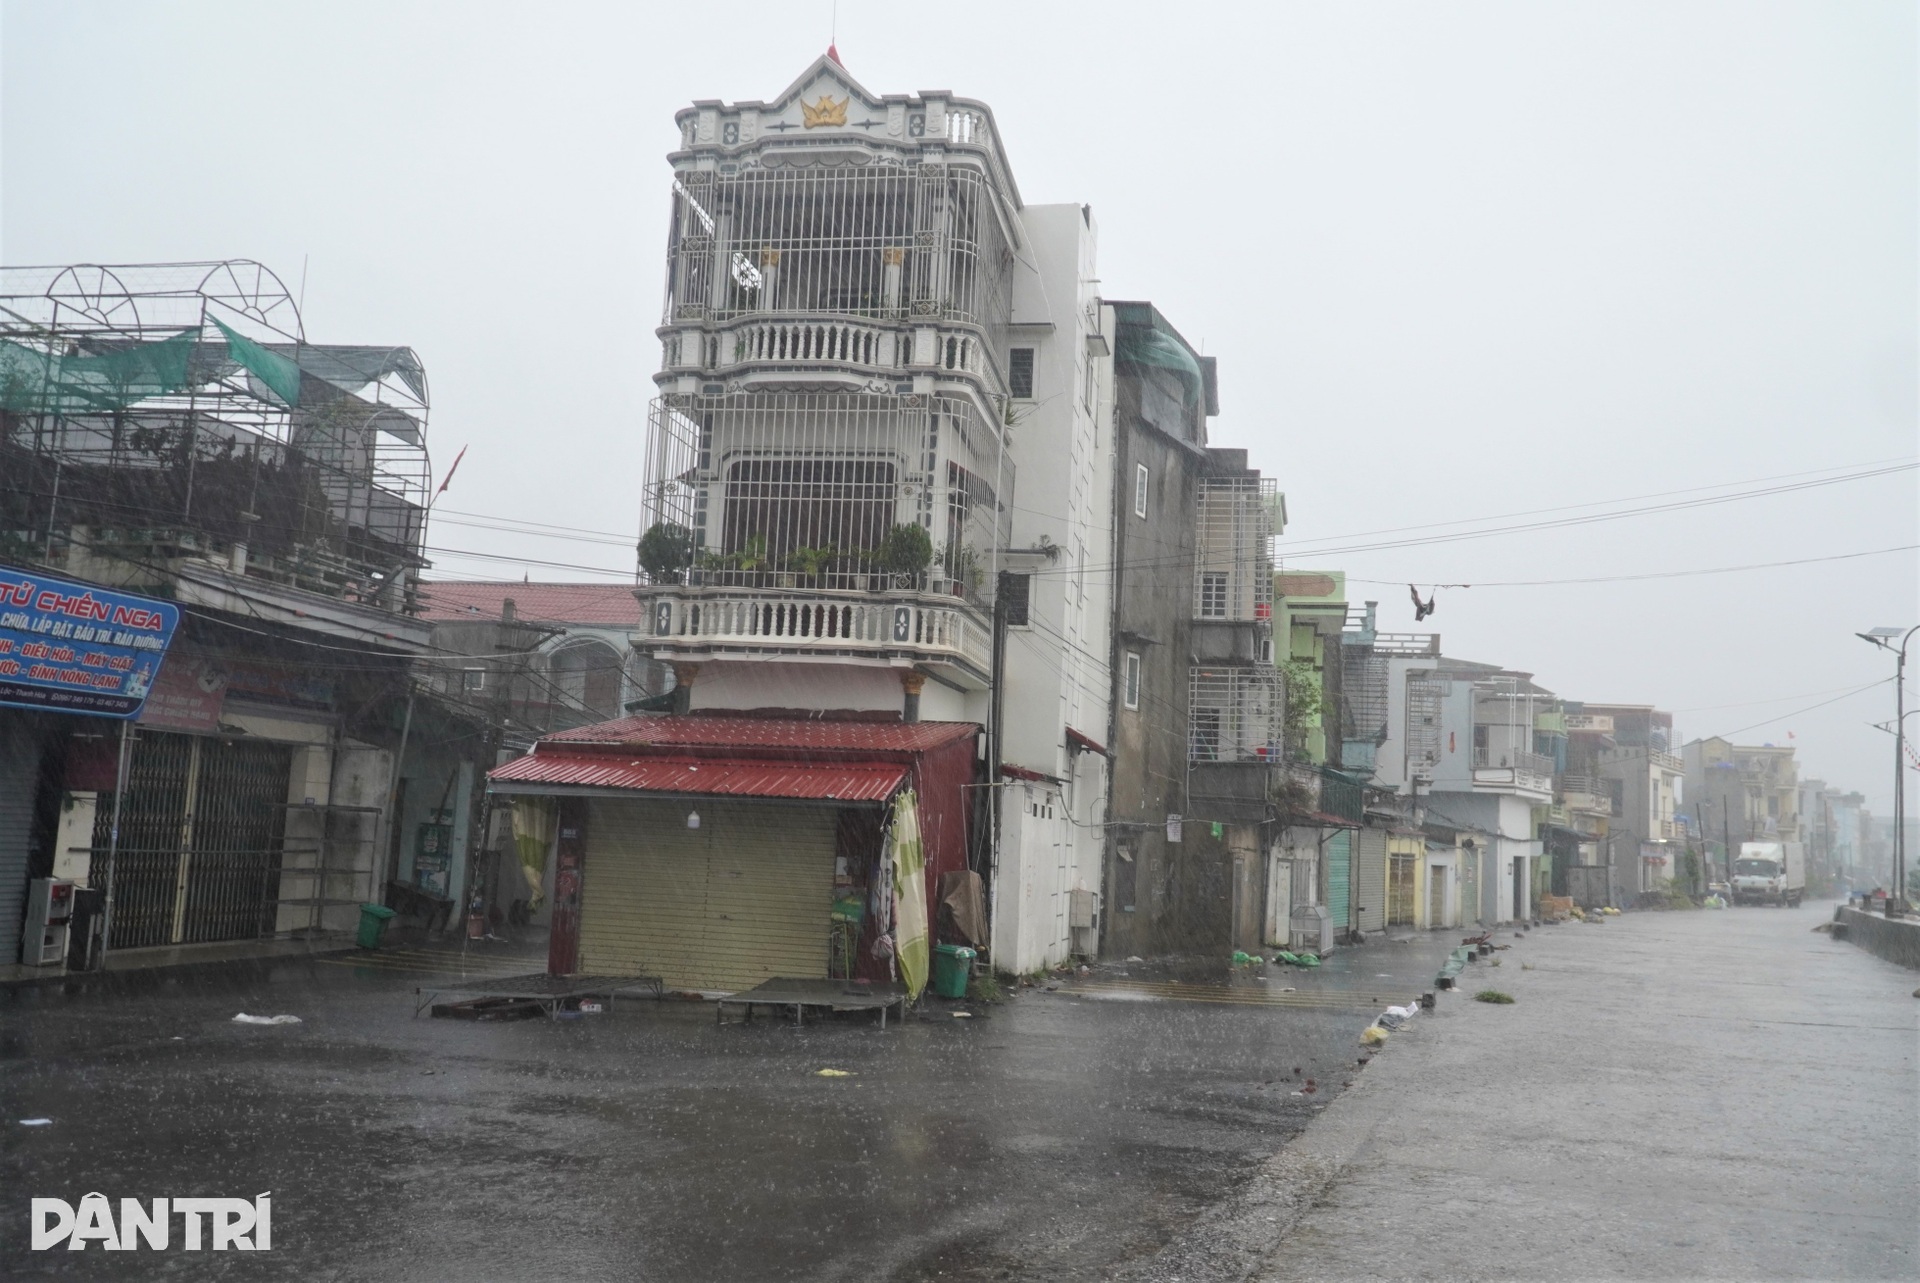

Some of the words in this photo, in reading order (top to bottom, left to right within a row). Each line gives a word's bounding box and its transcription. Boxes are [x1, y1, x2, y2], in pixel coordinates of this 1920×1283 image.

[0, 581, 36, 607] TỬ
[36, 592, 112, 621] CHIẾN
[112, 604, 163, 631] NGA
[31, 614, 52, 633] LẮP
[73, 622, 94, 641] BẢO
[20, 641, 51, 660] ĐIỀU
[50, 645, 75, 663] HÒA
[82, 651, 110, 669] MÁY
[108, 655, 135, 672] GIẶT
[27, 663, 59, 681] BÌNH
[58, 667, 92, 685] NÓNG
[91, 672, 122, 689] LẠNH
[15, 688, 34, 698] Thanh
